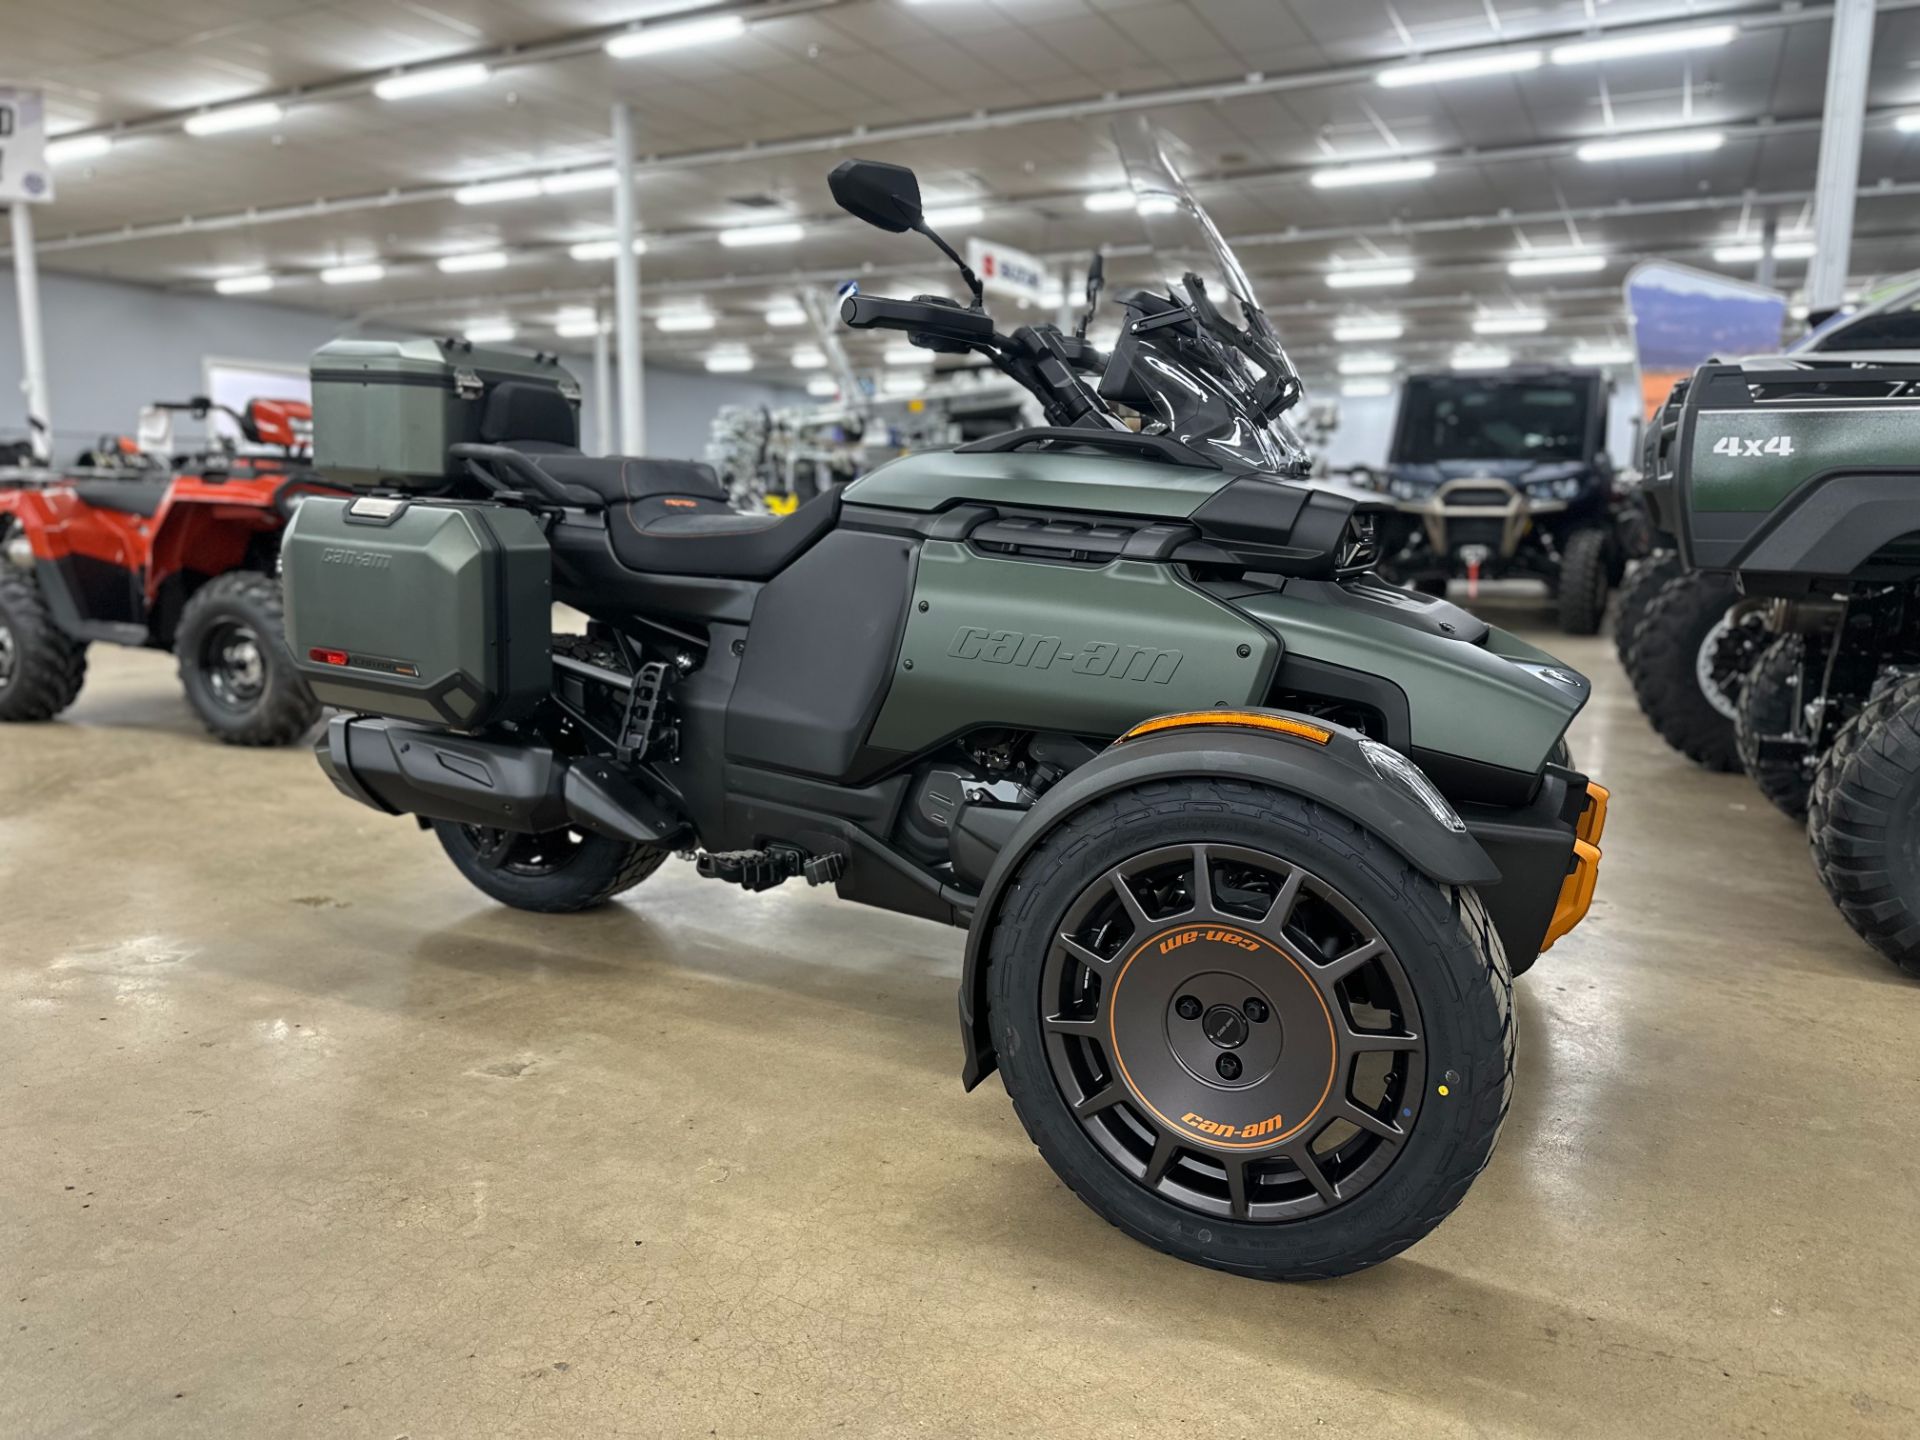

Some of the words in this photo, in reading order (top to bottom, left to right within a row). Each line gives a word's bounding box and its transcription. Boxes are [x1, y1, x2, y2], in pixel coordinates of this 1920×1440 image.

[1712, 436, 1795, 457] 4x4
[321, 546, 393, 570] can-am
[947, 625, 1184, 685] can-am
[1159, 930, 1260, 955] can-am
[1180, 1111, 1282, 1139] can-am
